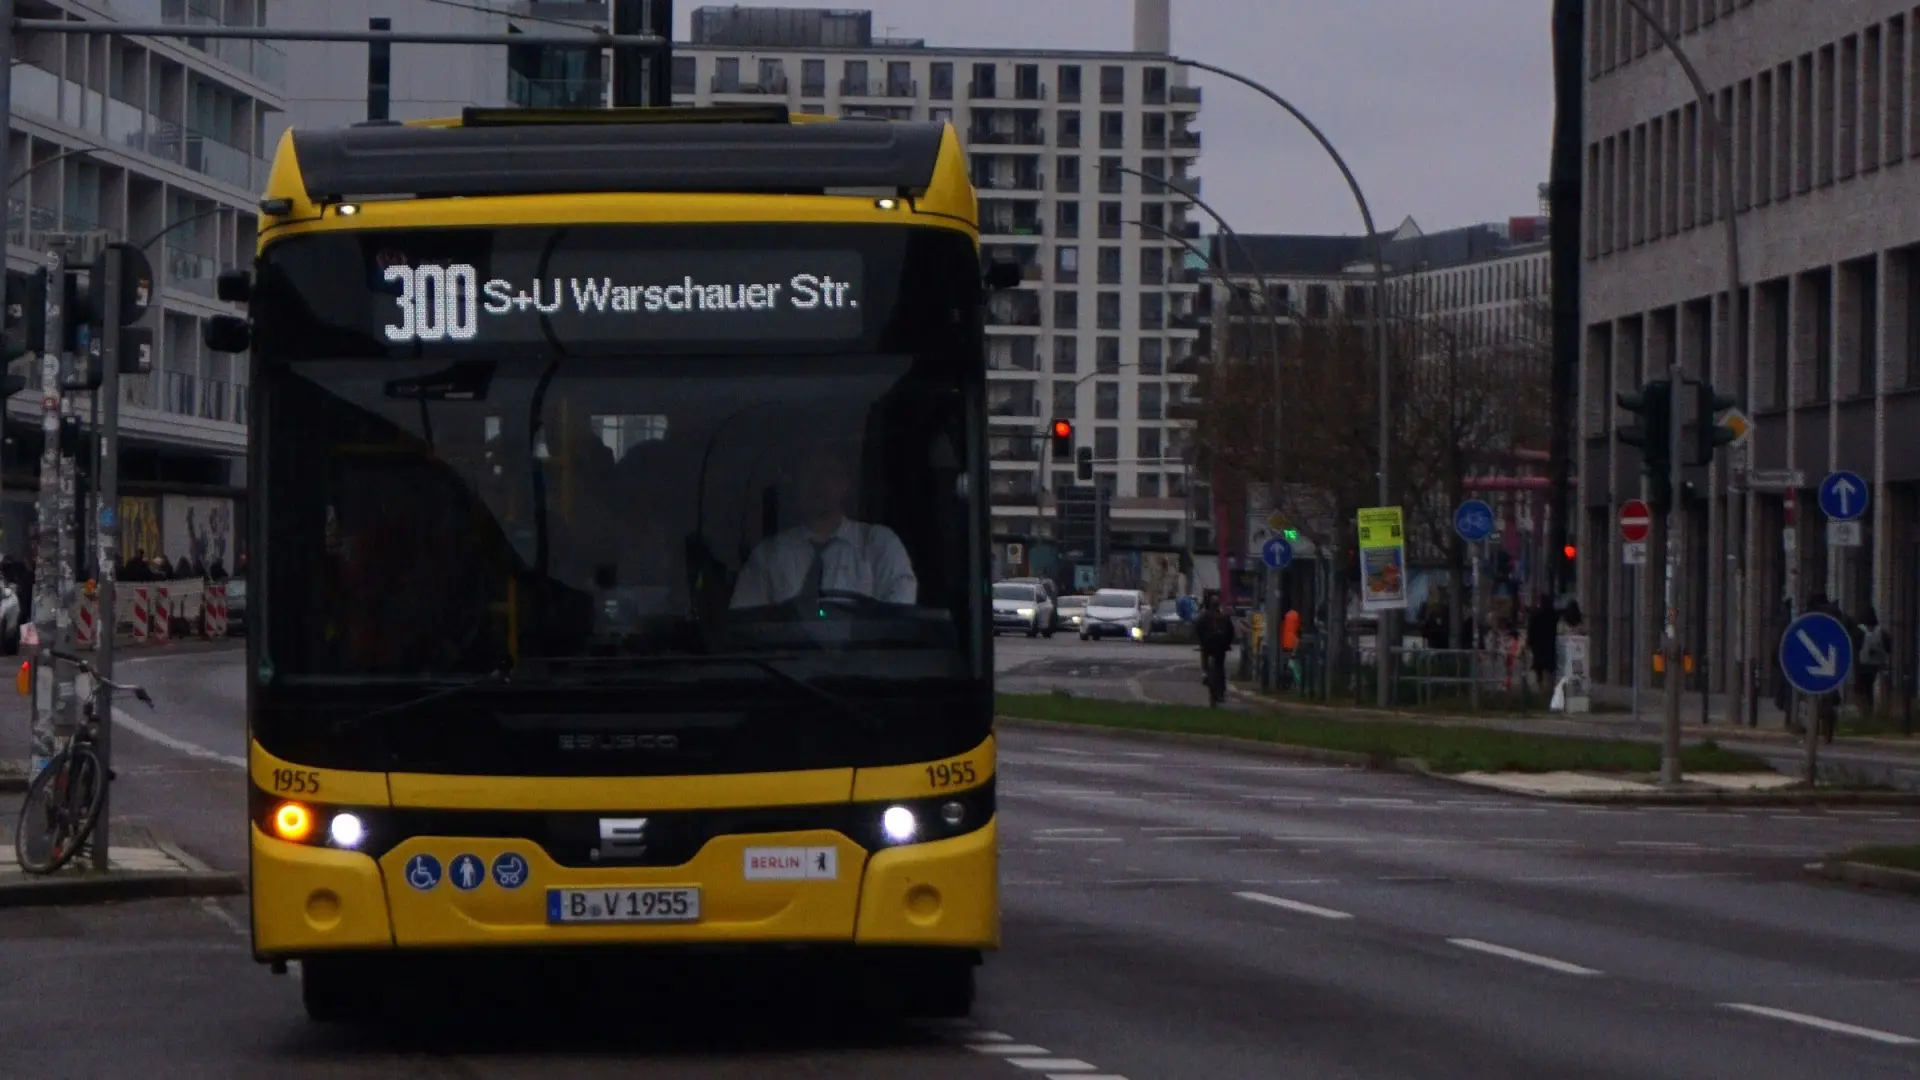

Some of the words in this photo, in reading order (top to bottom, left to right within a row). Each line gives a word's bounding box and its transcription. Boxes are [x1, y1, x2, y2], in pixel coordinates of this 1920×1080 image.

[383, 263, 478, 340] 300
[483, 277, 562, 313] S+U
[570, 275, 780, 312] Warschauer
[789, 273, 857, 308] Str.
[272, 767, 320, 794] 1955
[925, 760, 976, 788] 1955
[750, 855, 800, 869] BERLIN
[570, 891, 587, 917] B
[603, 891, 620, 917] V
[626, 890, 689, 916] 1955
